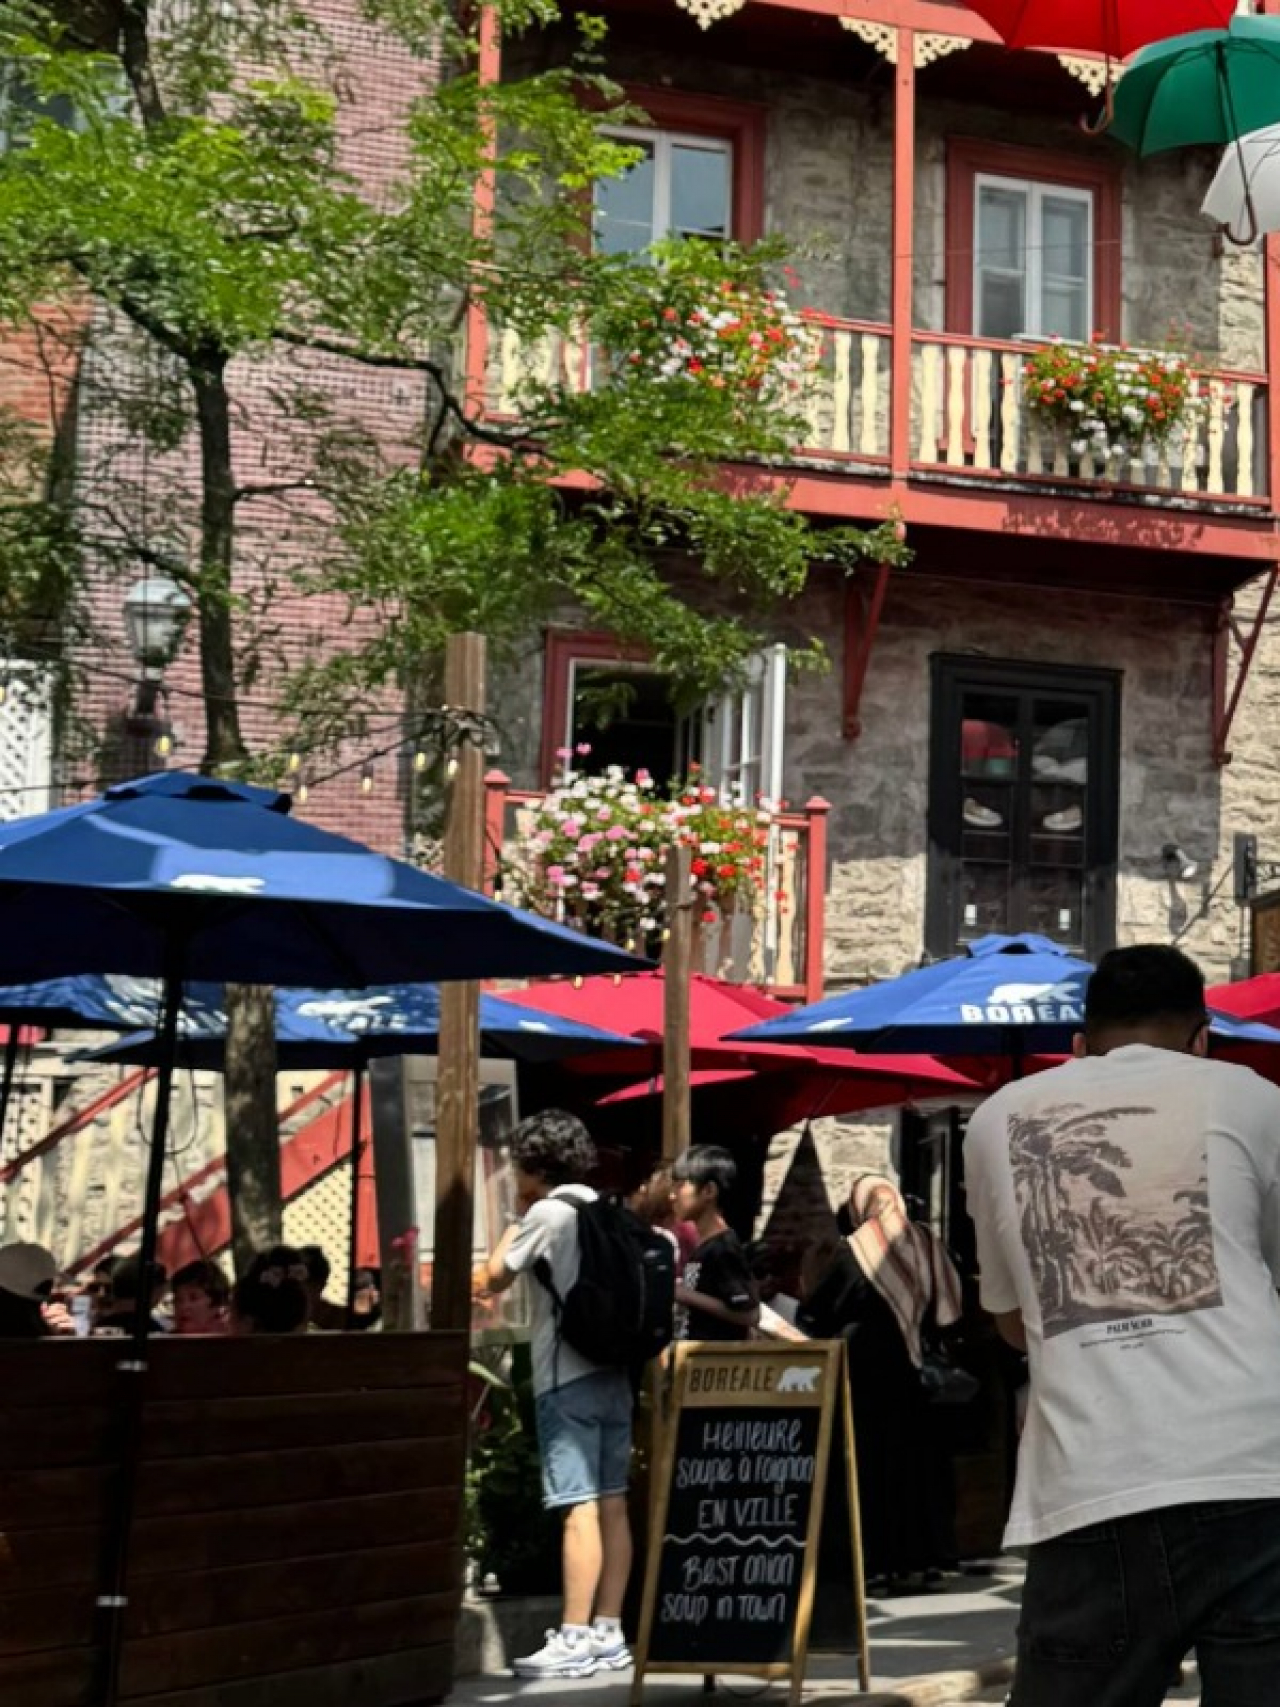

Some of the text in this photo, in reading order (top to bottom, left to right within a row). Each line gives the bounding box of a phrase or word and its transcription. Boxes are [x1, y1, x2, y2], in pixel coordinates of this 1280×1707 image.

[962, 1004, 1087, 1023] BOREA
[698, 1494, 799, 1529] EN VILLE
